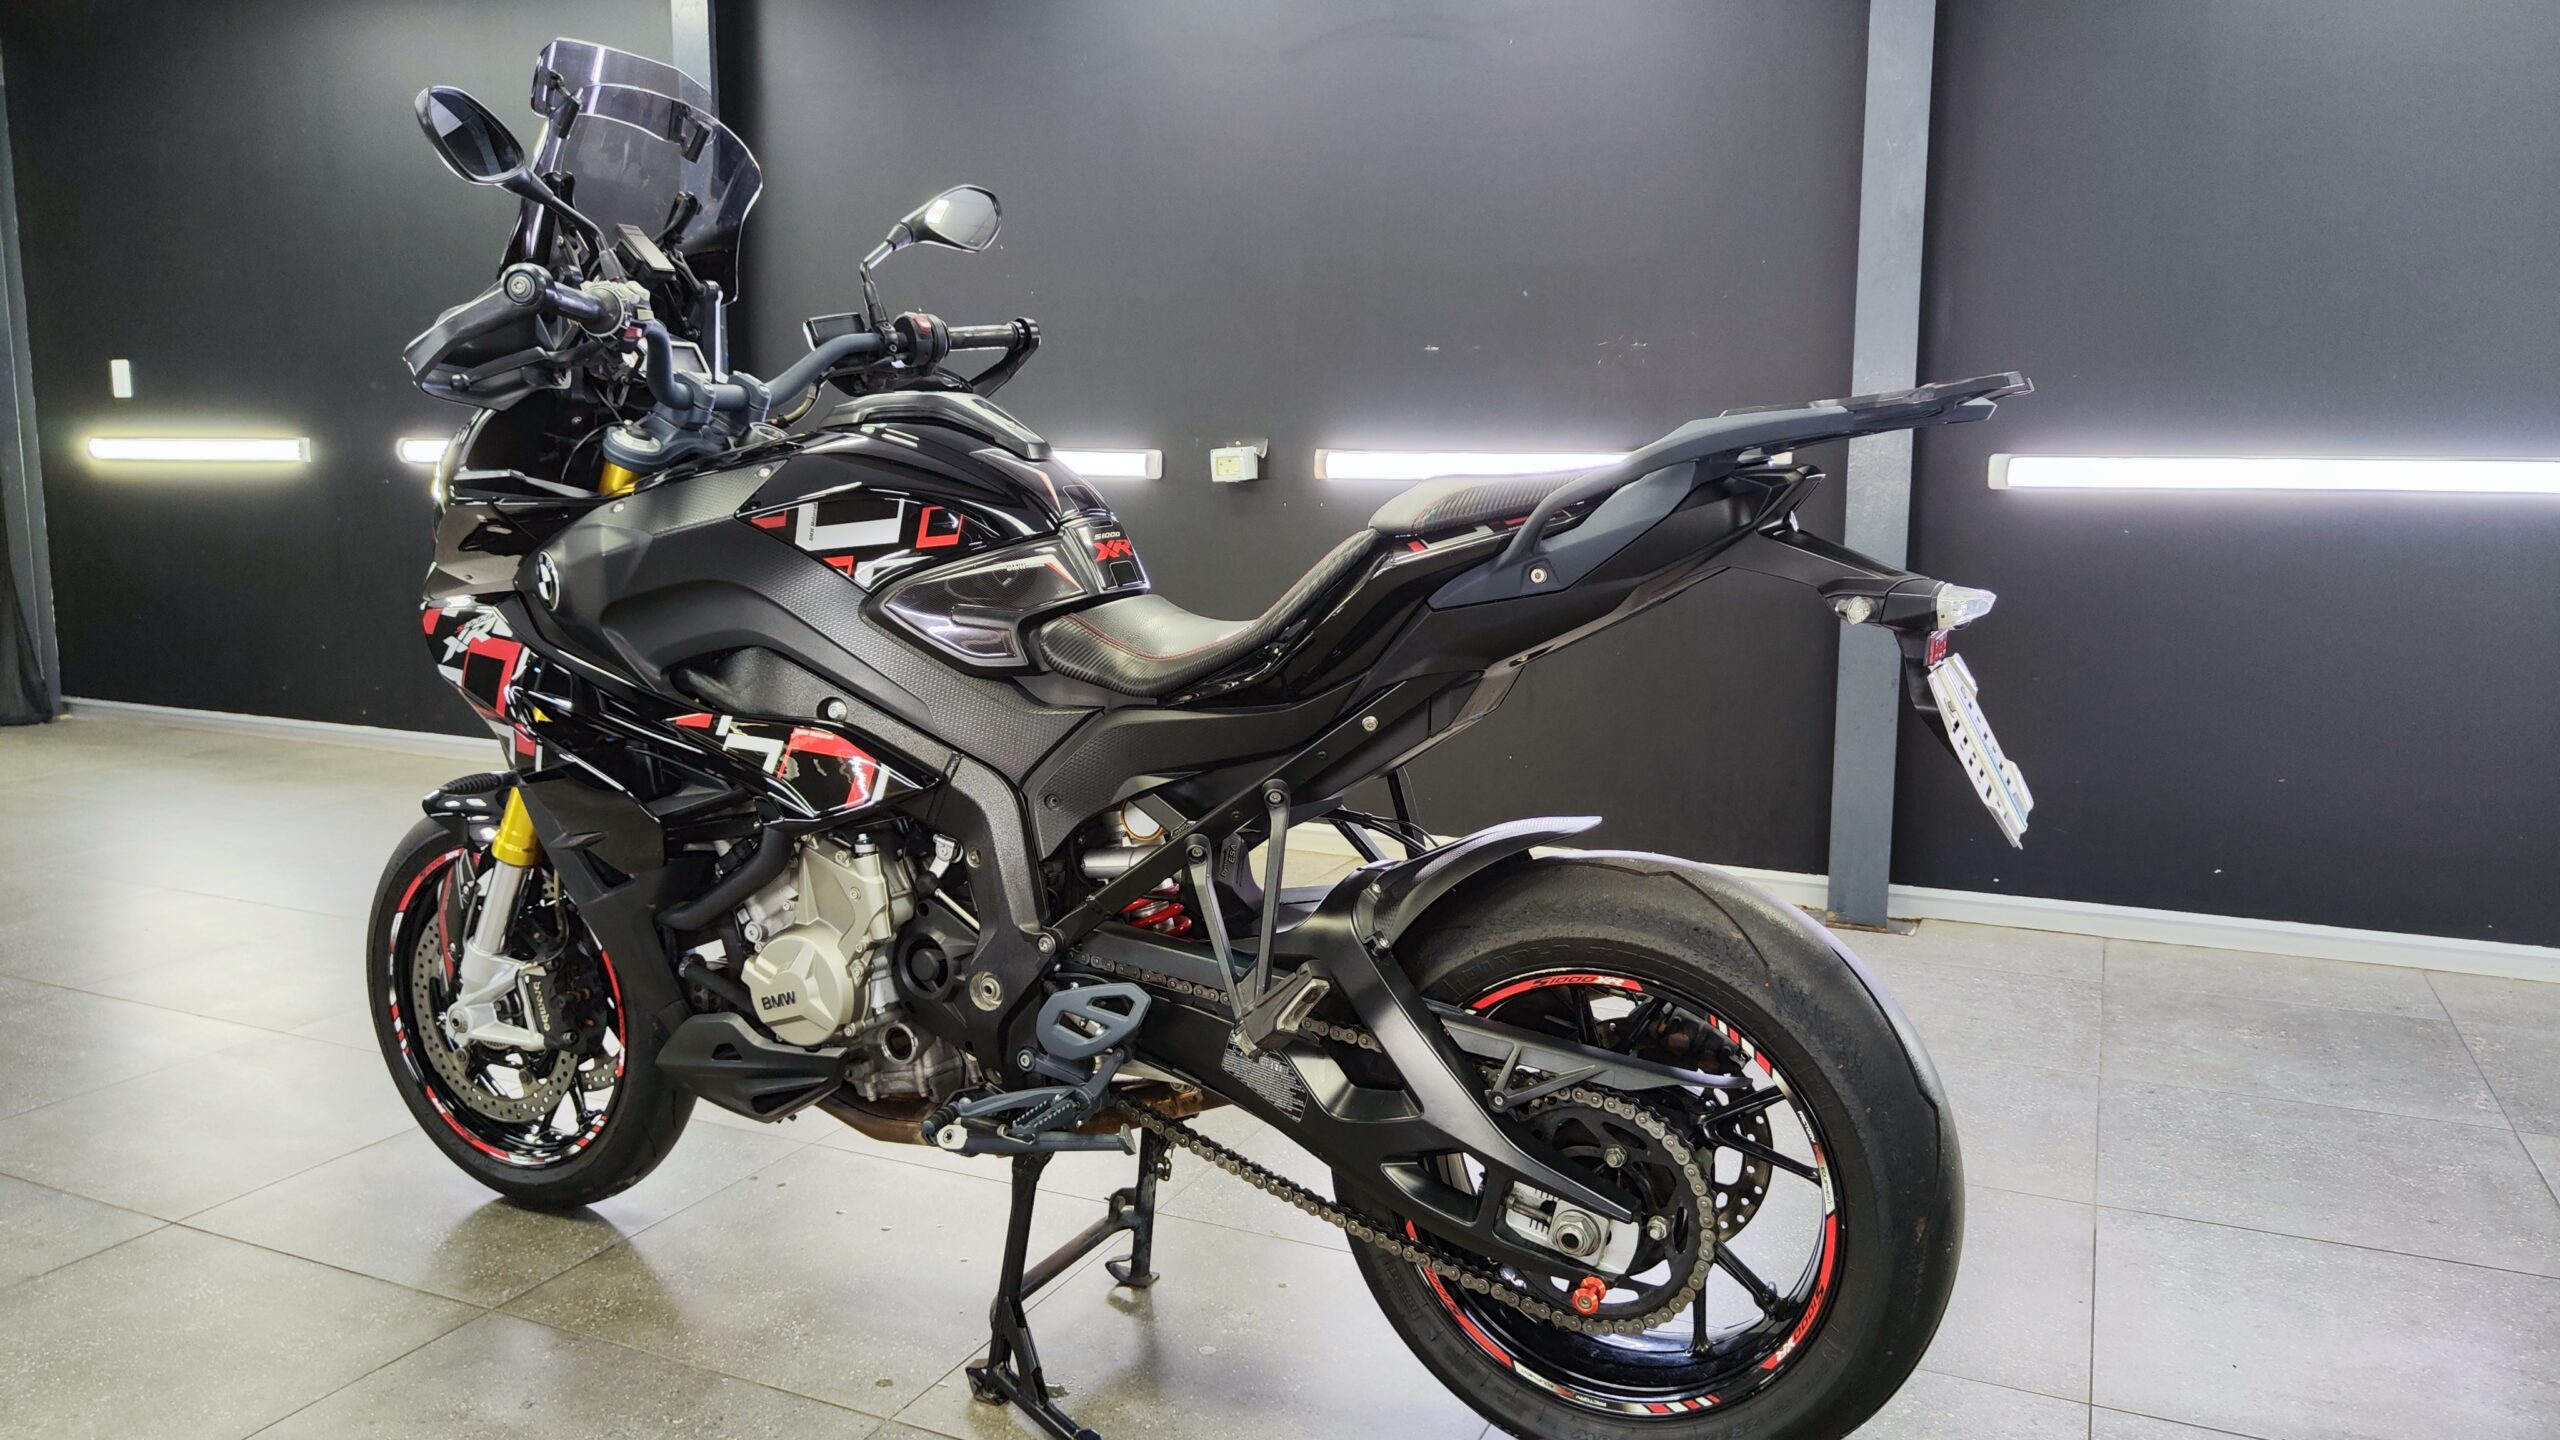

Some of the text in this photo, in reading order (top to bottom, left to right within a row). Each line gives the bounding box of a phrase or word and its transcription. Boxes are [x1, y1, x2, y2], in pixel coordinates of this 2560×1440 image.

[1093, 530, 1121, 541] S1000
[1093, 539, 1134, 561] XR
[1228, 844, 1238, 863] ESA
[533, 980, 551, 1031] brembo
[761, 990, 796, 1010] BMW
